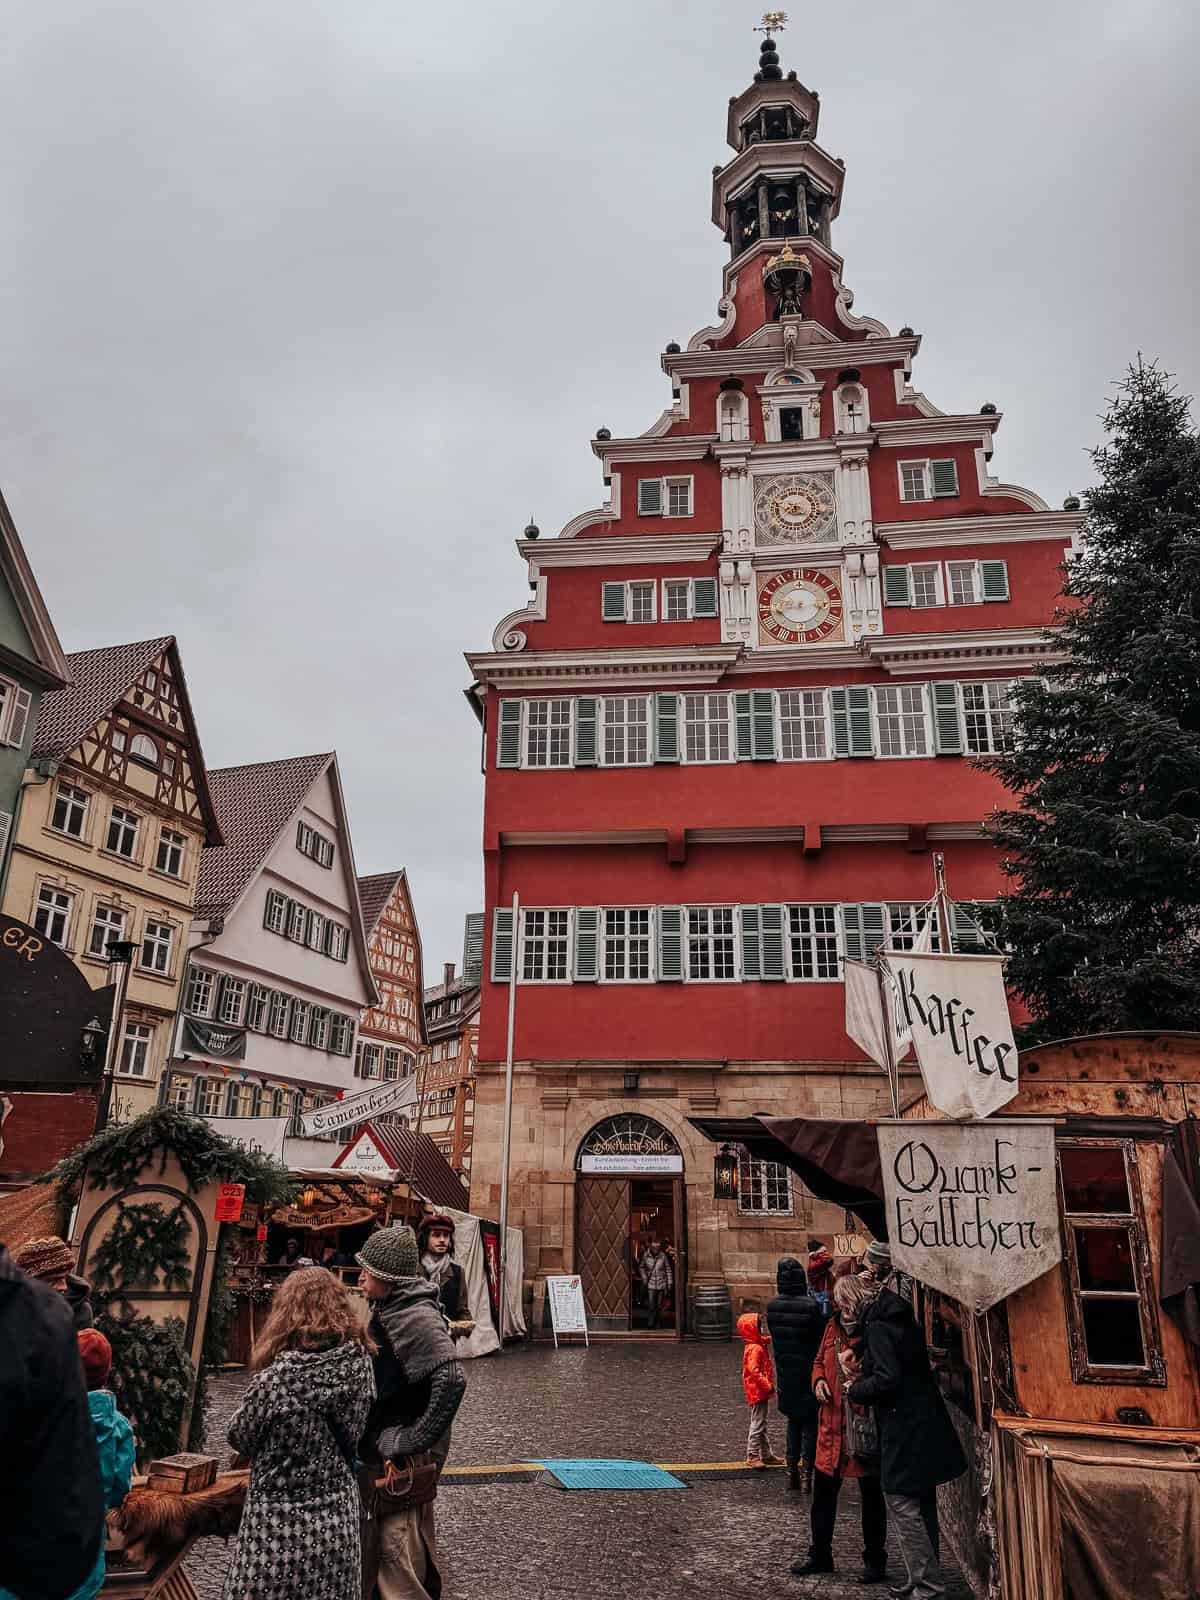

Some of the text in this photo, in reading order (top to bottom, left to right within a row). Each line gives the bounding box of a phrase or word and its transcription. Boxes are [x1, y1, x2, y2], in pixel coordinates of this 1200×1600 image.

[0, 927, 43, 962] ER
[897, 968, 1017, 1083] Kaffee
[312, 1088, 399, 1130] Camembert
[896, 1196, 1041, 1255] bällchen
